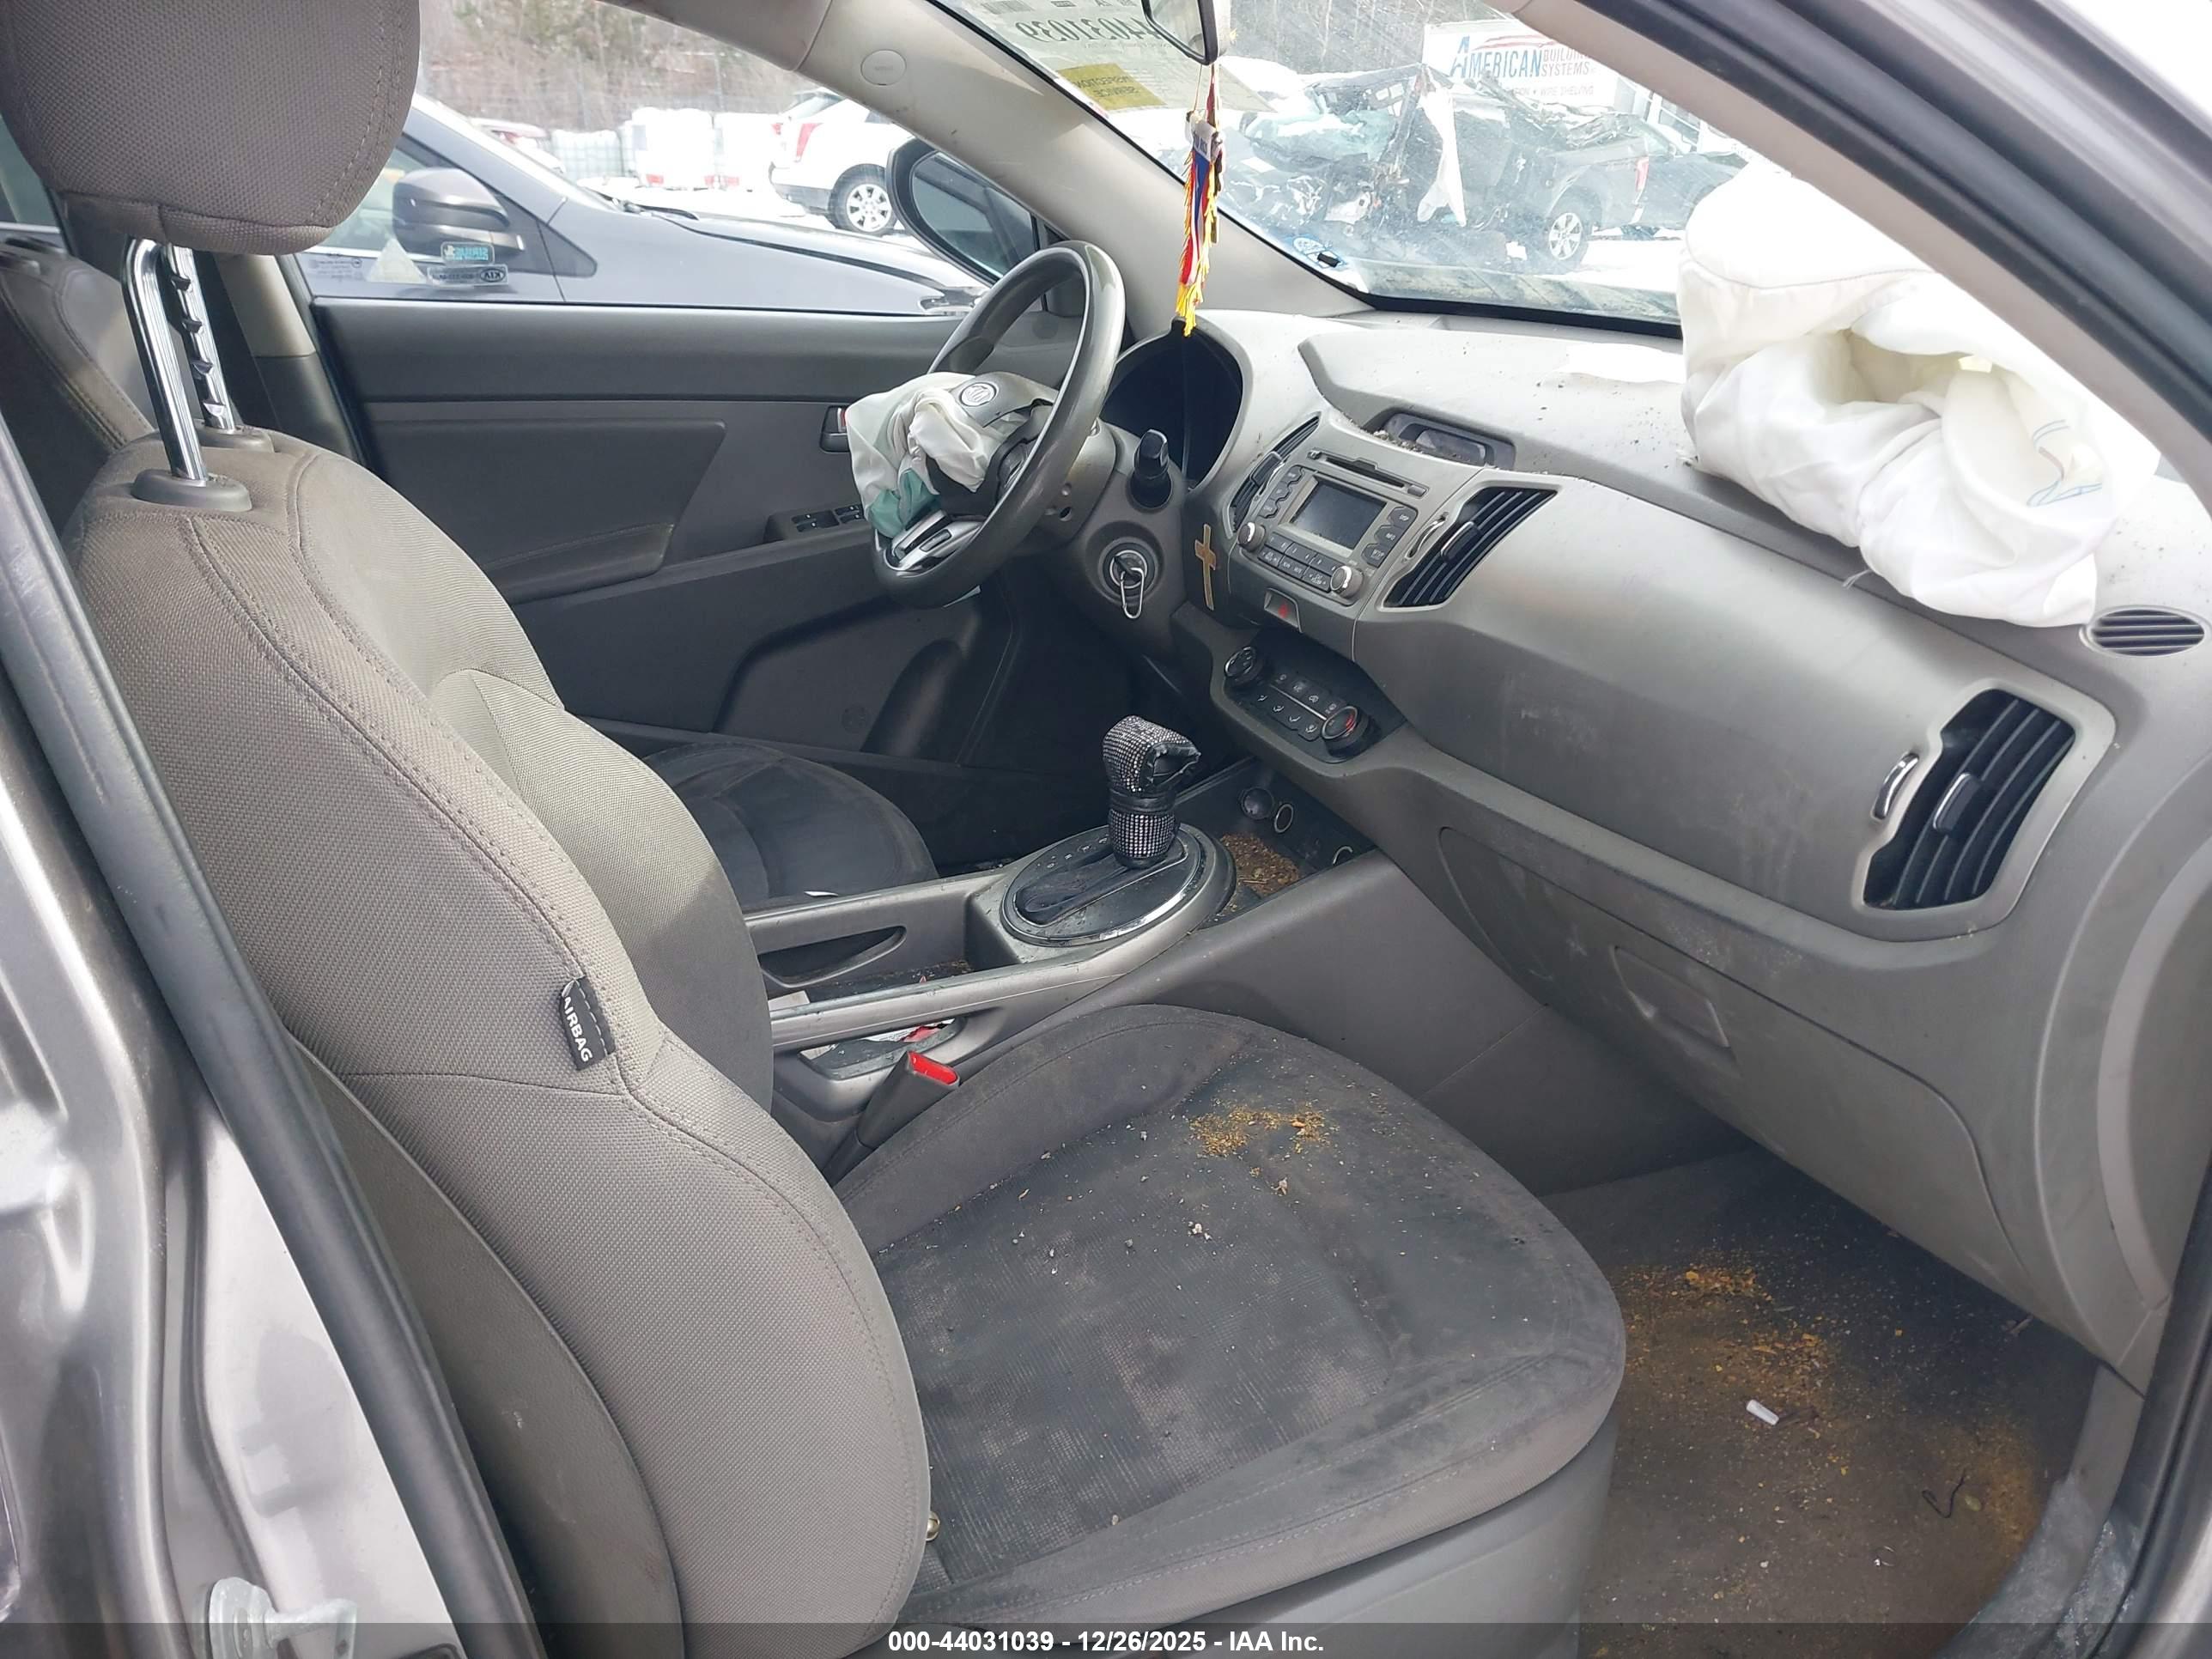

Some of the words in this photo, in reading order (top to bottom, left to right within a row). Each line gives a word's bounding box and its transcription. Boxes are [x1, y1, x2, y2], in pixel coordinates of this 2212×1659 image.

[1449, 35, 1542, 78] AMERICAN
[1540, 62, 1589, 76] SYSTEMS
[564, 996, 592, 1062] AIRBAG
